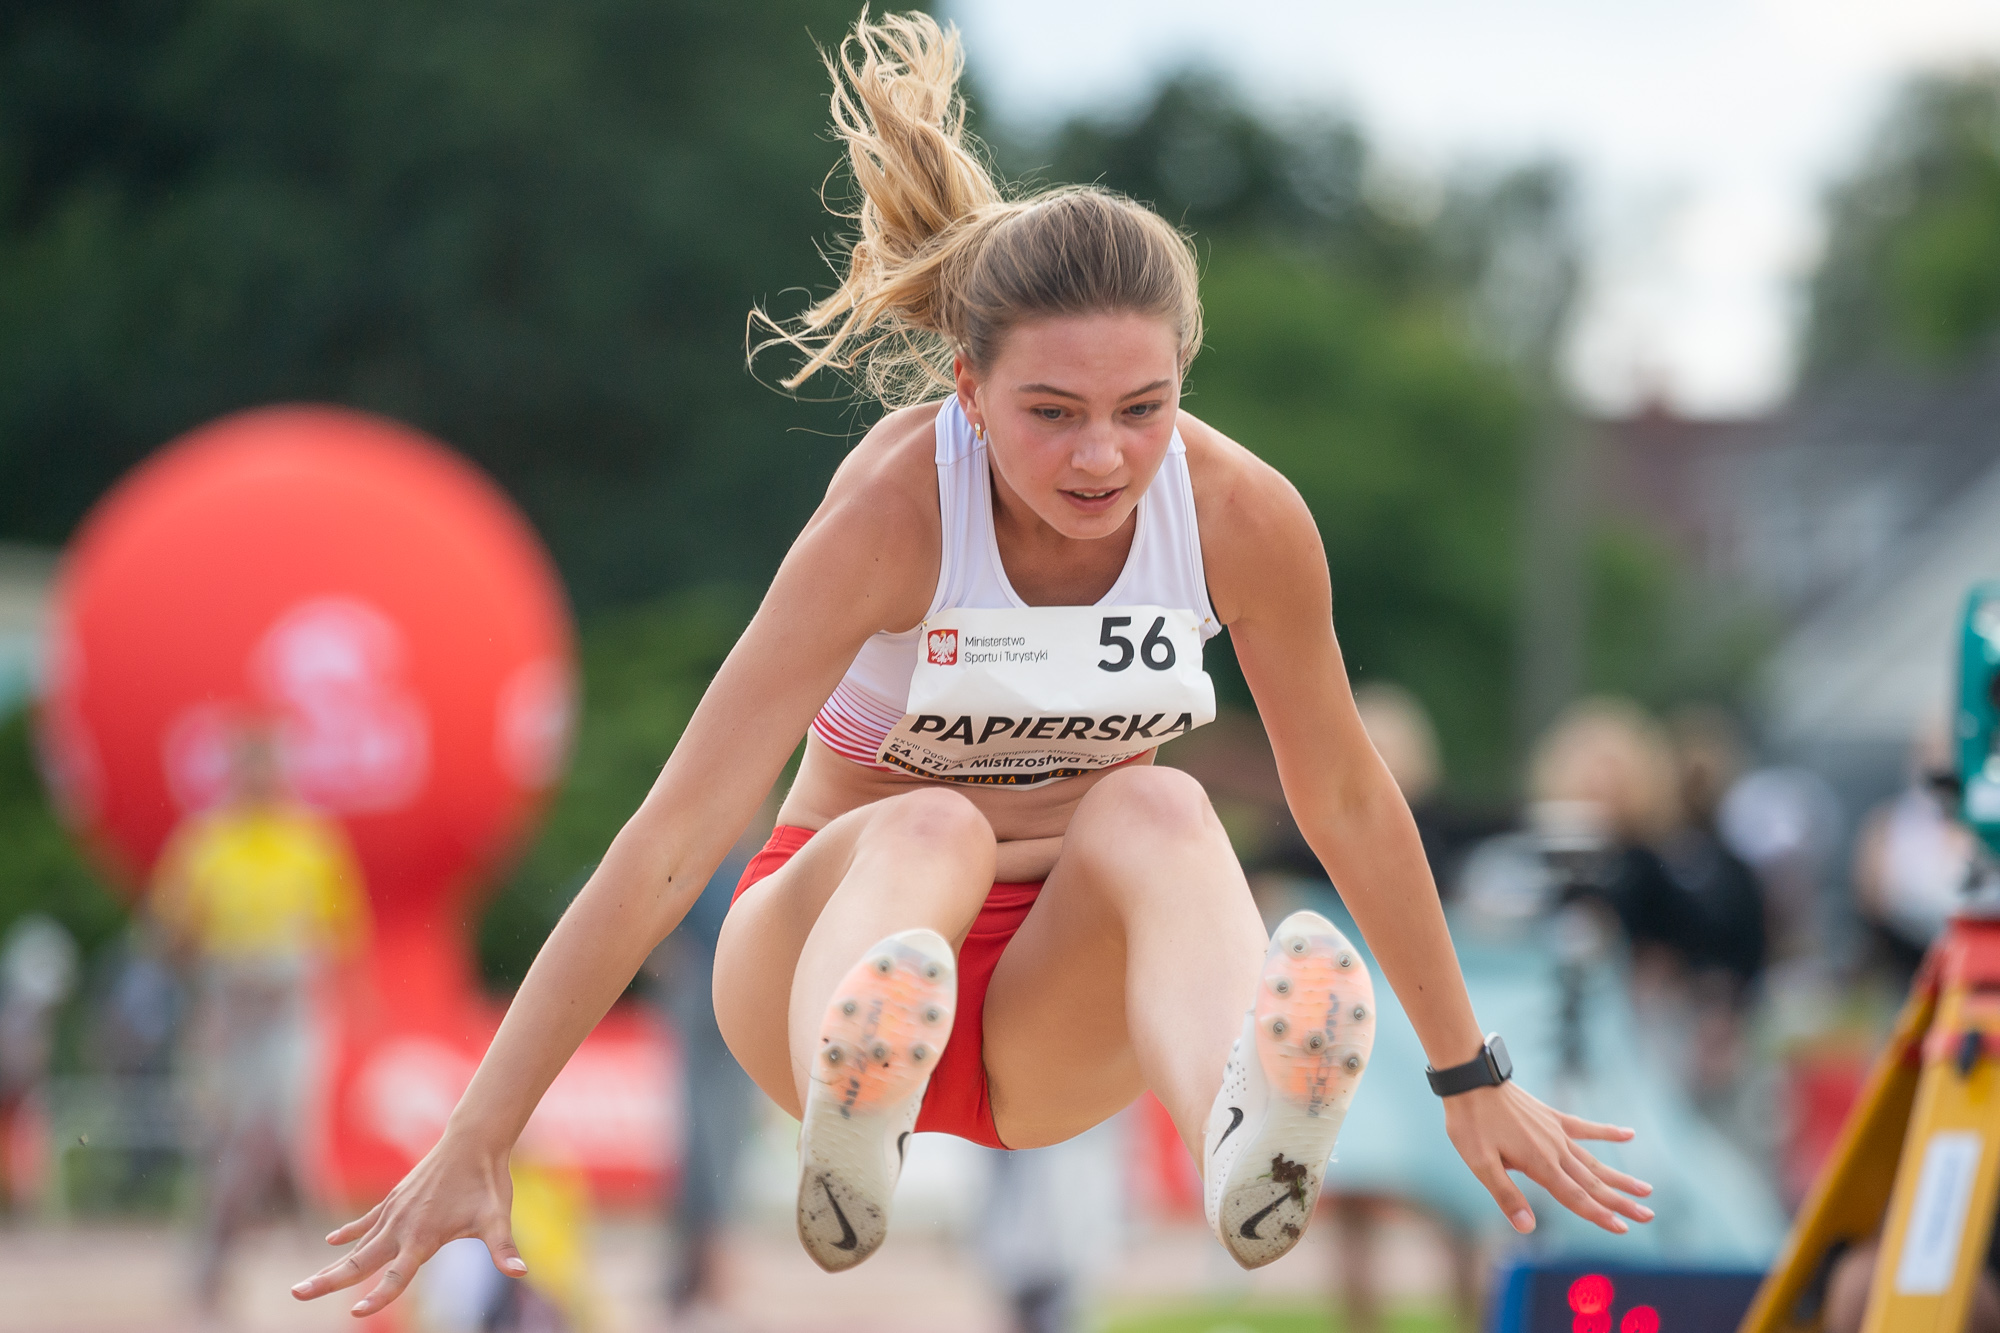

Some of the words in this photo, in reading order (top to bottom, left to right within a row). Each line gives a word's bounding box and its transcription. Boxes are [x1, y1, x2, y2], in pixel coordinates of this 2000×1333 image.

[965, 636, 1026, 648] Ministerstwo
[1097, 616, 1177, 673] 56
[964, 651, 998, 665] Sportu
[1004, 649, 1049, 663] Turystyki
[909, 712, 1193, 746] PAPIERSKA
[888, 743, 914, 760] 54.
[970, 754, 1081, 769] Mistrzostwa
[1086, 755, 1131, 765] Polsk
